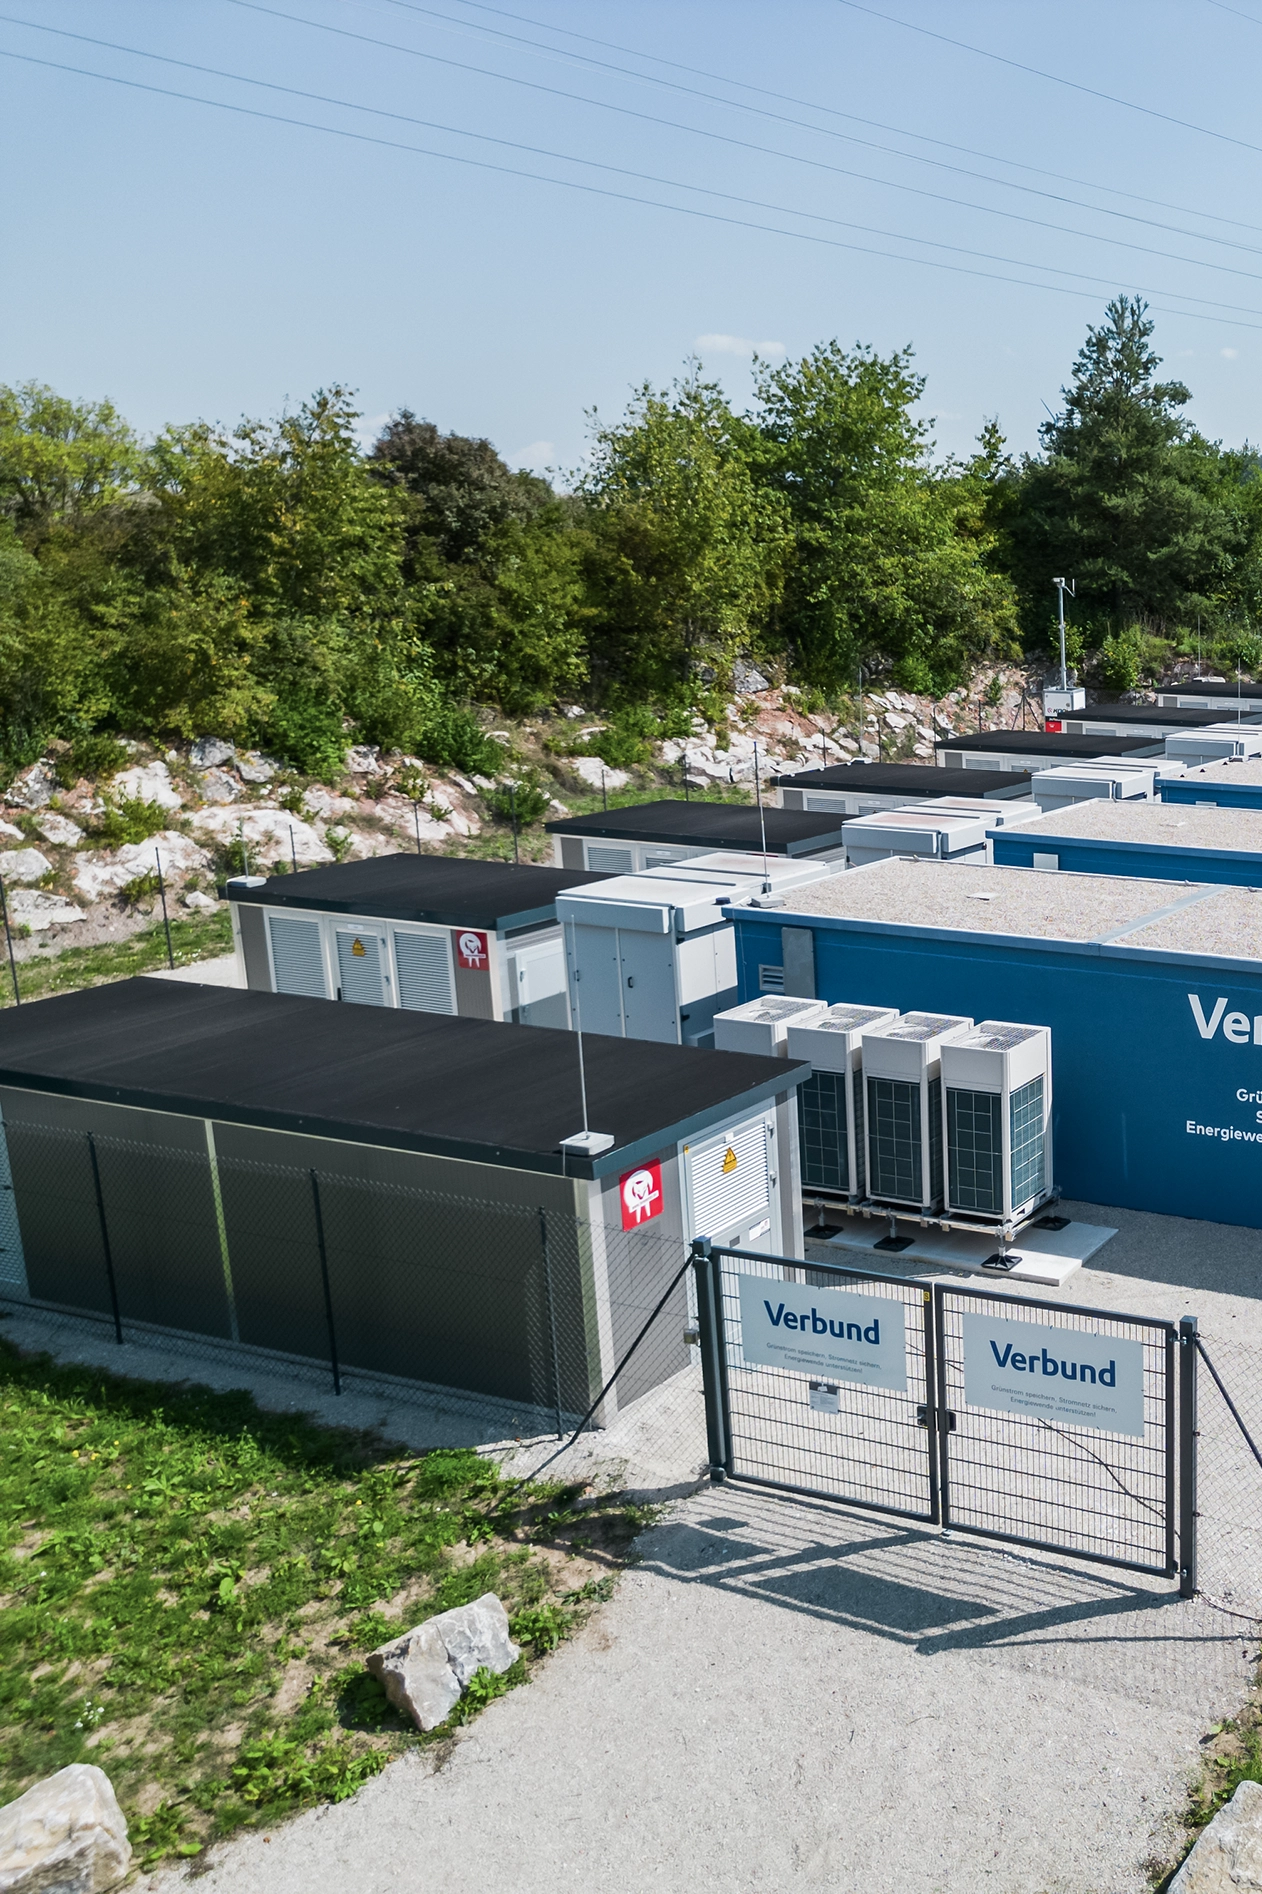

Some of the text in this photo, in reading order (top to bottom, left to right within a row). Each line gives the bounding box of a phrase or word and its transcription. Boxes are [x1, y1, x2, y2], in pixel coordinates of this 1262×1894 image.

[763, 1300, 880, 1344] Verbund
[766, 1342, 796, 1353] Grünstrom
[828, 1354, 858, 1365] Stromnetz
[784, 1354, 824, 1367] Energiewende
[989, 1340, 1116, 1388] Verbund
[991, 1384, 1024, 1396] Grünstrom
[1059, 1397, 1091, 1408] Stromnetz
[1010, 1396, 1054, 1410] Energiewende
